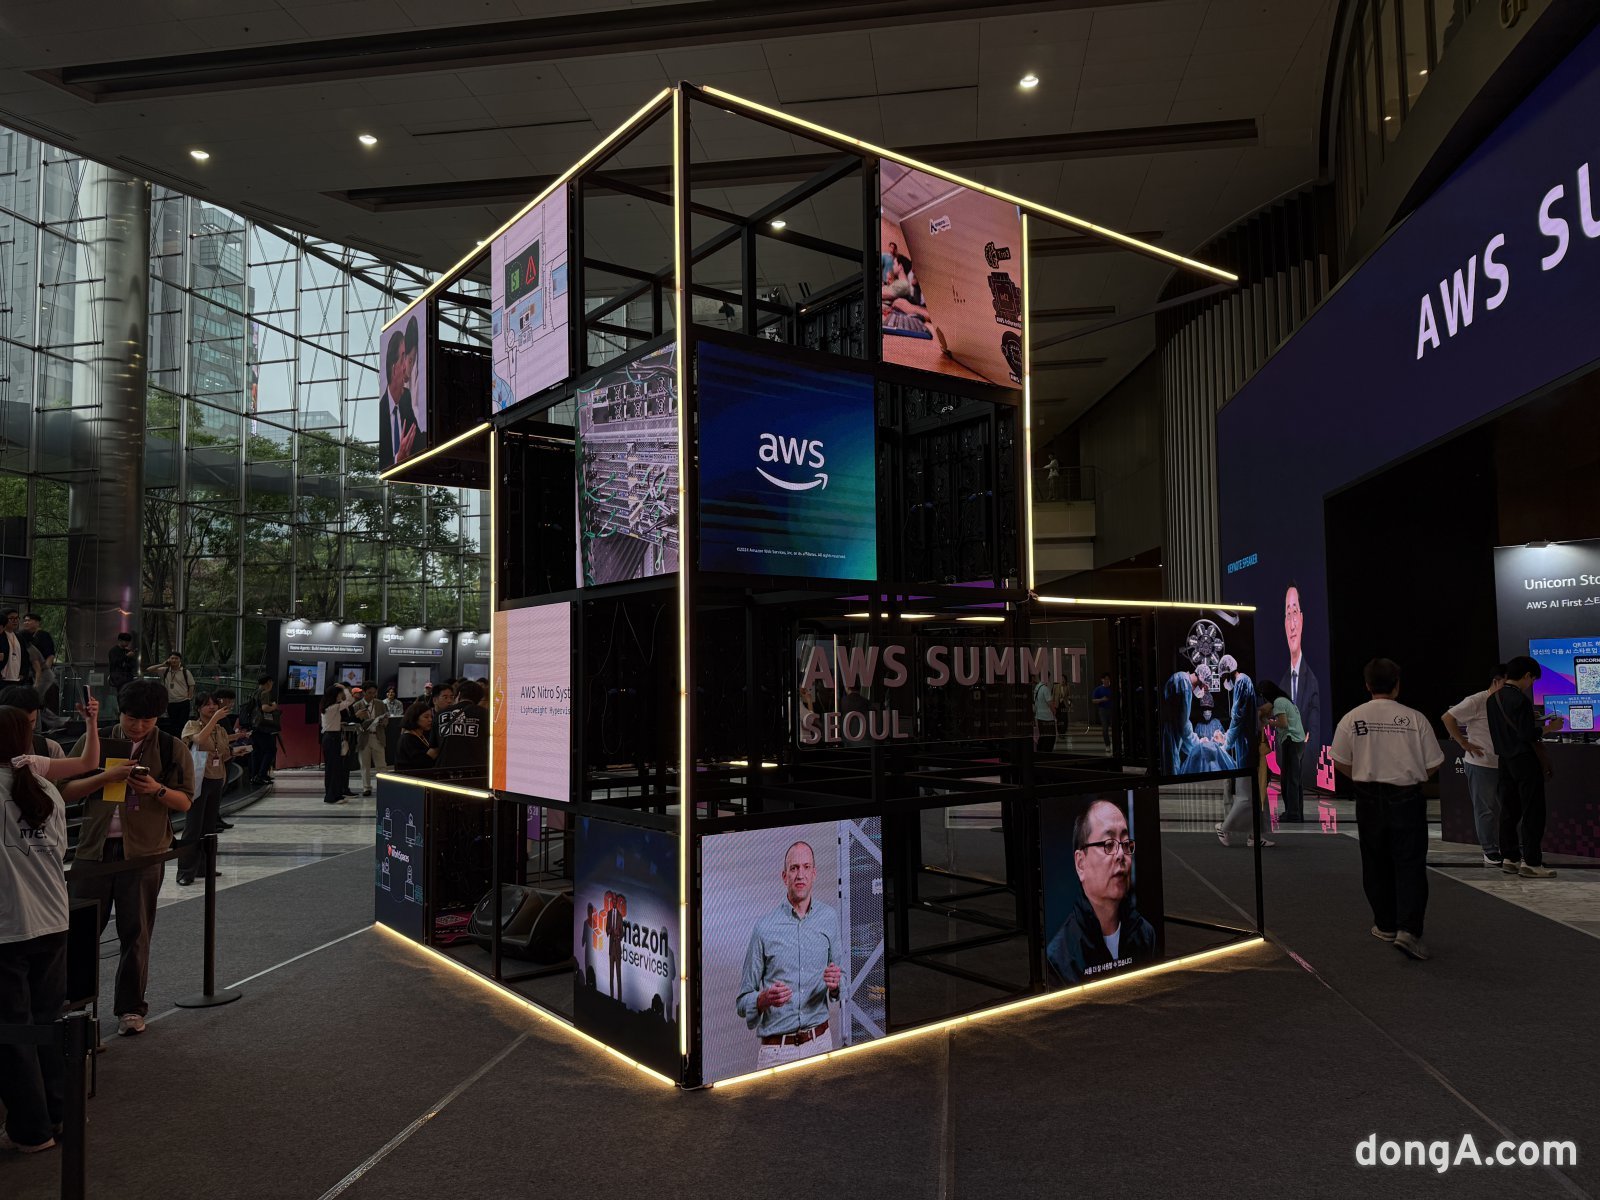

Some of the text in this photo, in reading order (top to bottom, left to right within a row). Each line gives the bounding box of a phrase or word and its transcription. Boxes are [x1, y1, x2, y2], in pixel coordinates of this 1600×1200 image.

[1416, 233, 1510, 360] AWS
[758, 432, 825, 469] aws
[1524, 577, 1576, 590] Unicorn
[1526, 600, 1548, 610] AWS
[1549, 599, 1559, 608] AI
[1561, 598, 1583, 608] First
[801, 644, 1087, 689] AWS SUMMIT
[520, 685, 536, 699] AWS
[537, 685, 554, 699] Nitro
[520, 705, 547, 716] Lightweight
[800, 709, 909, 745] SEOUL
[621, 919, 669, 958] mazon
[620, 944, 669, 978] bservices
